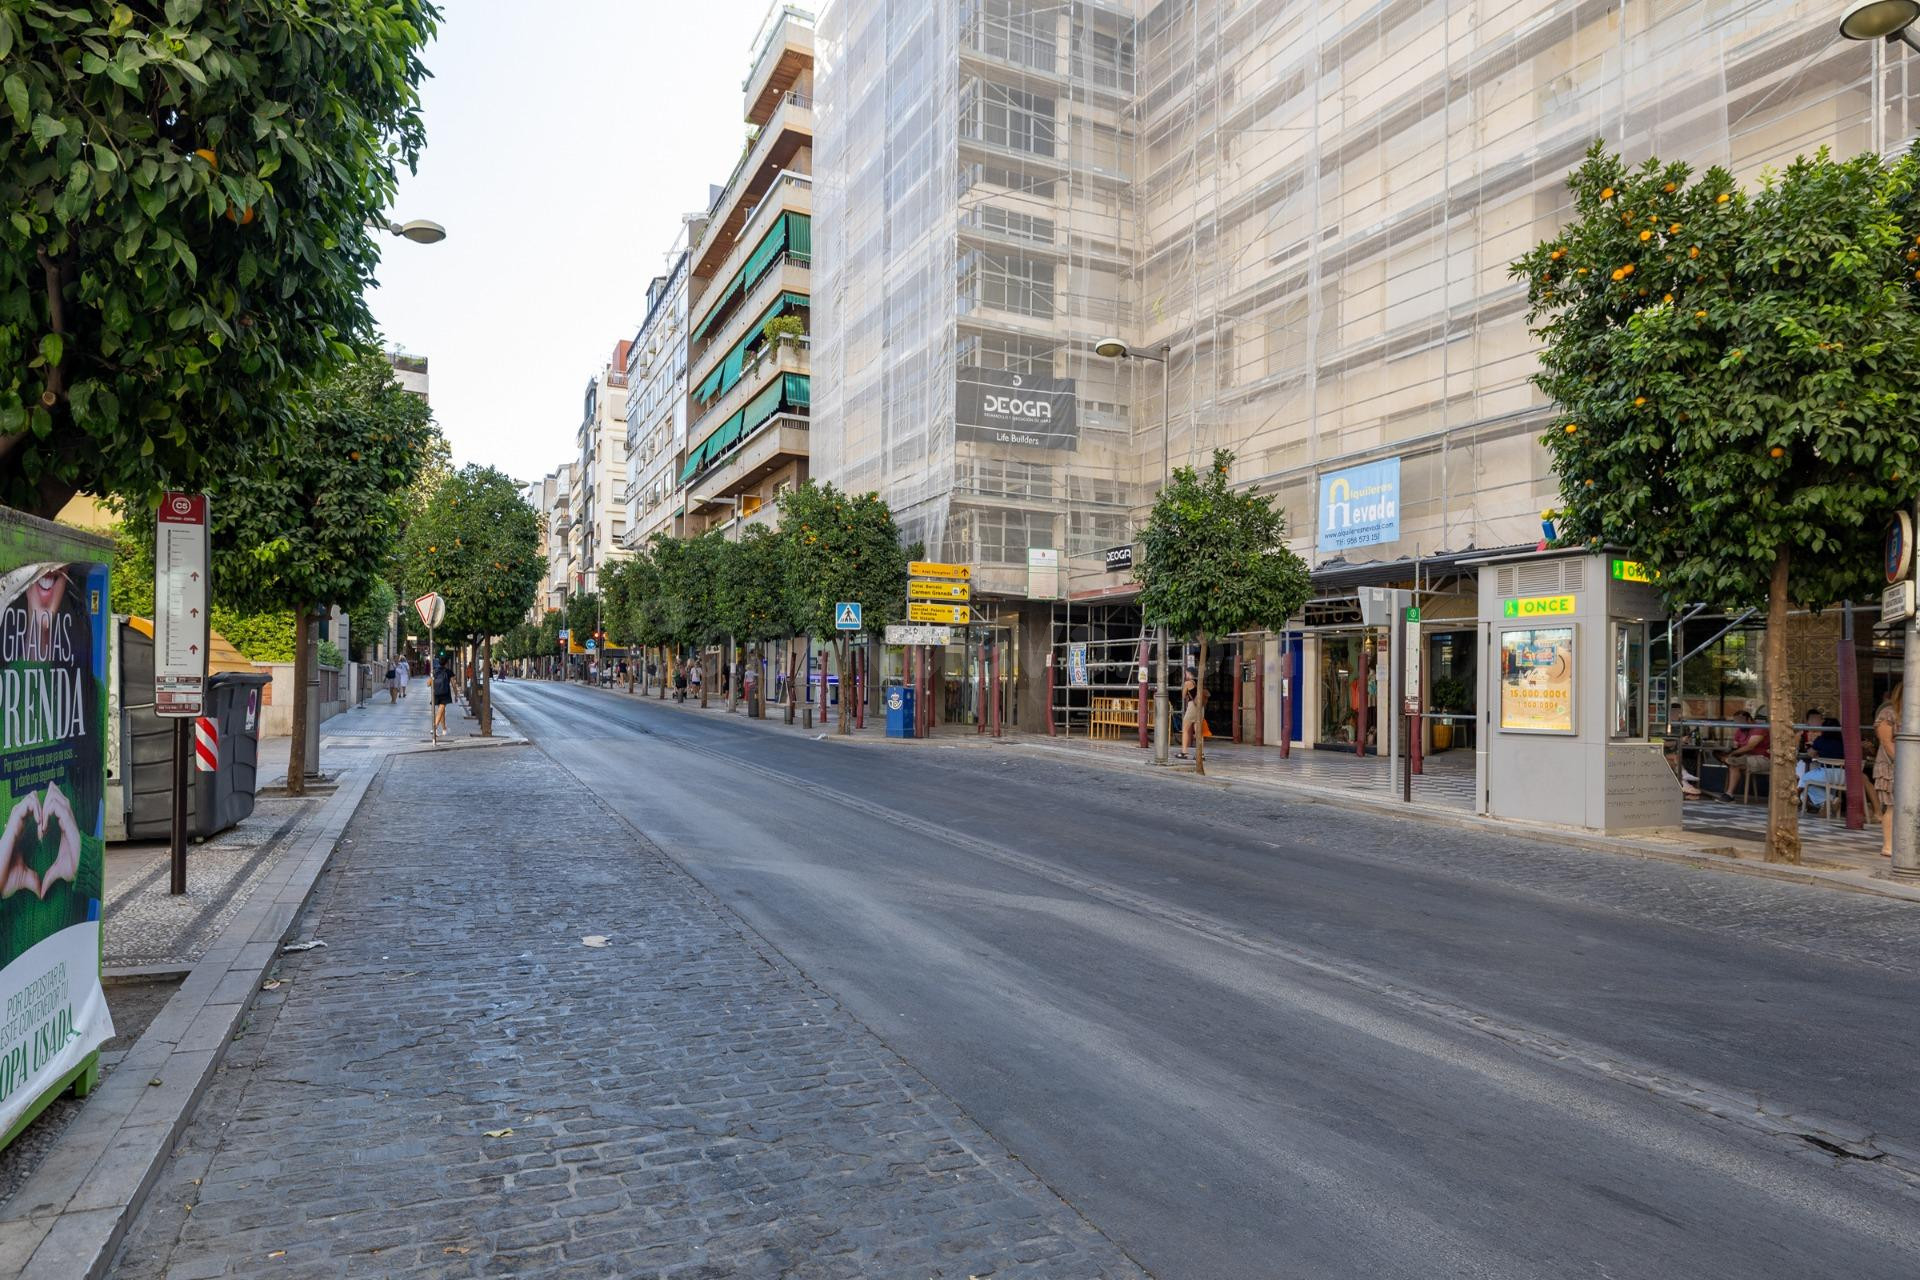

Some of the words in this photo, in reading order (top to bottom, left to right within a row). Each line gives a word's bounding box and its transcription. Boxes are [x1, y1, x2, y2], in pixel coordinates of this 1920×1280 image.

[983, 394, 1052, 418] DEOGA
[996, 432, 1010, 442] Life
[1011, 434, 1039, 445] Builders
[1106, 549, 1131, 562] DEOGA
[1524, 598, 1569, 613] ONCE
[3, 607, 74, 668] GRACIAS,
[0, 667, 86, 749] RENDA
[7, 993, 22, 1021] POR
[24, 968, 58, 1009] DEPOSITAR
[19, 990, 60, 1035] CONTENEDOR
[33, 1002, 80, 1072] USADA
